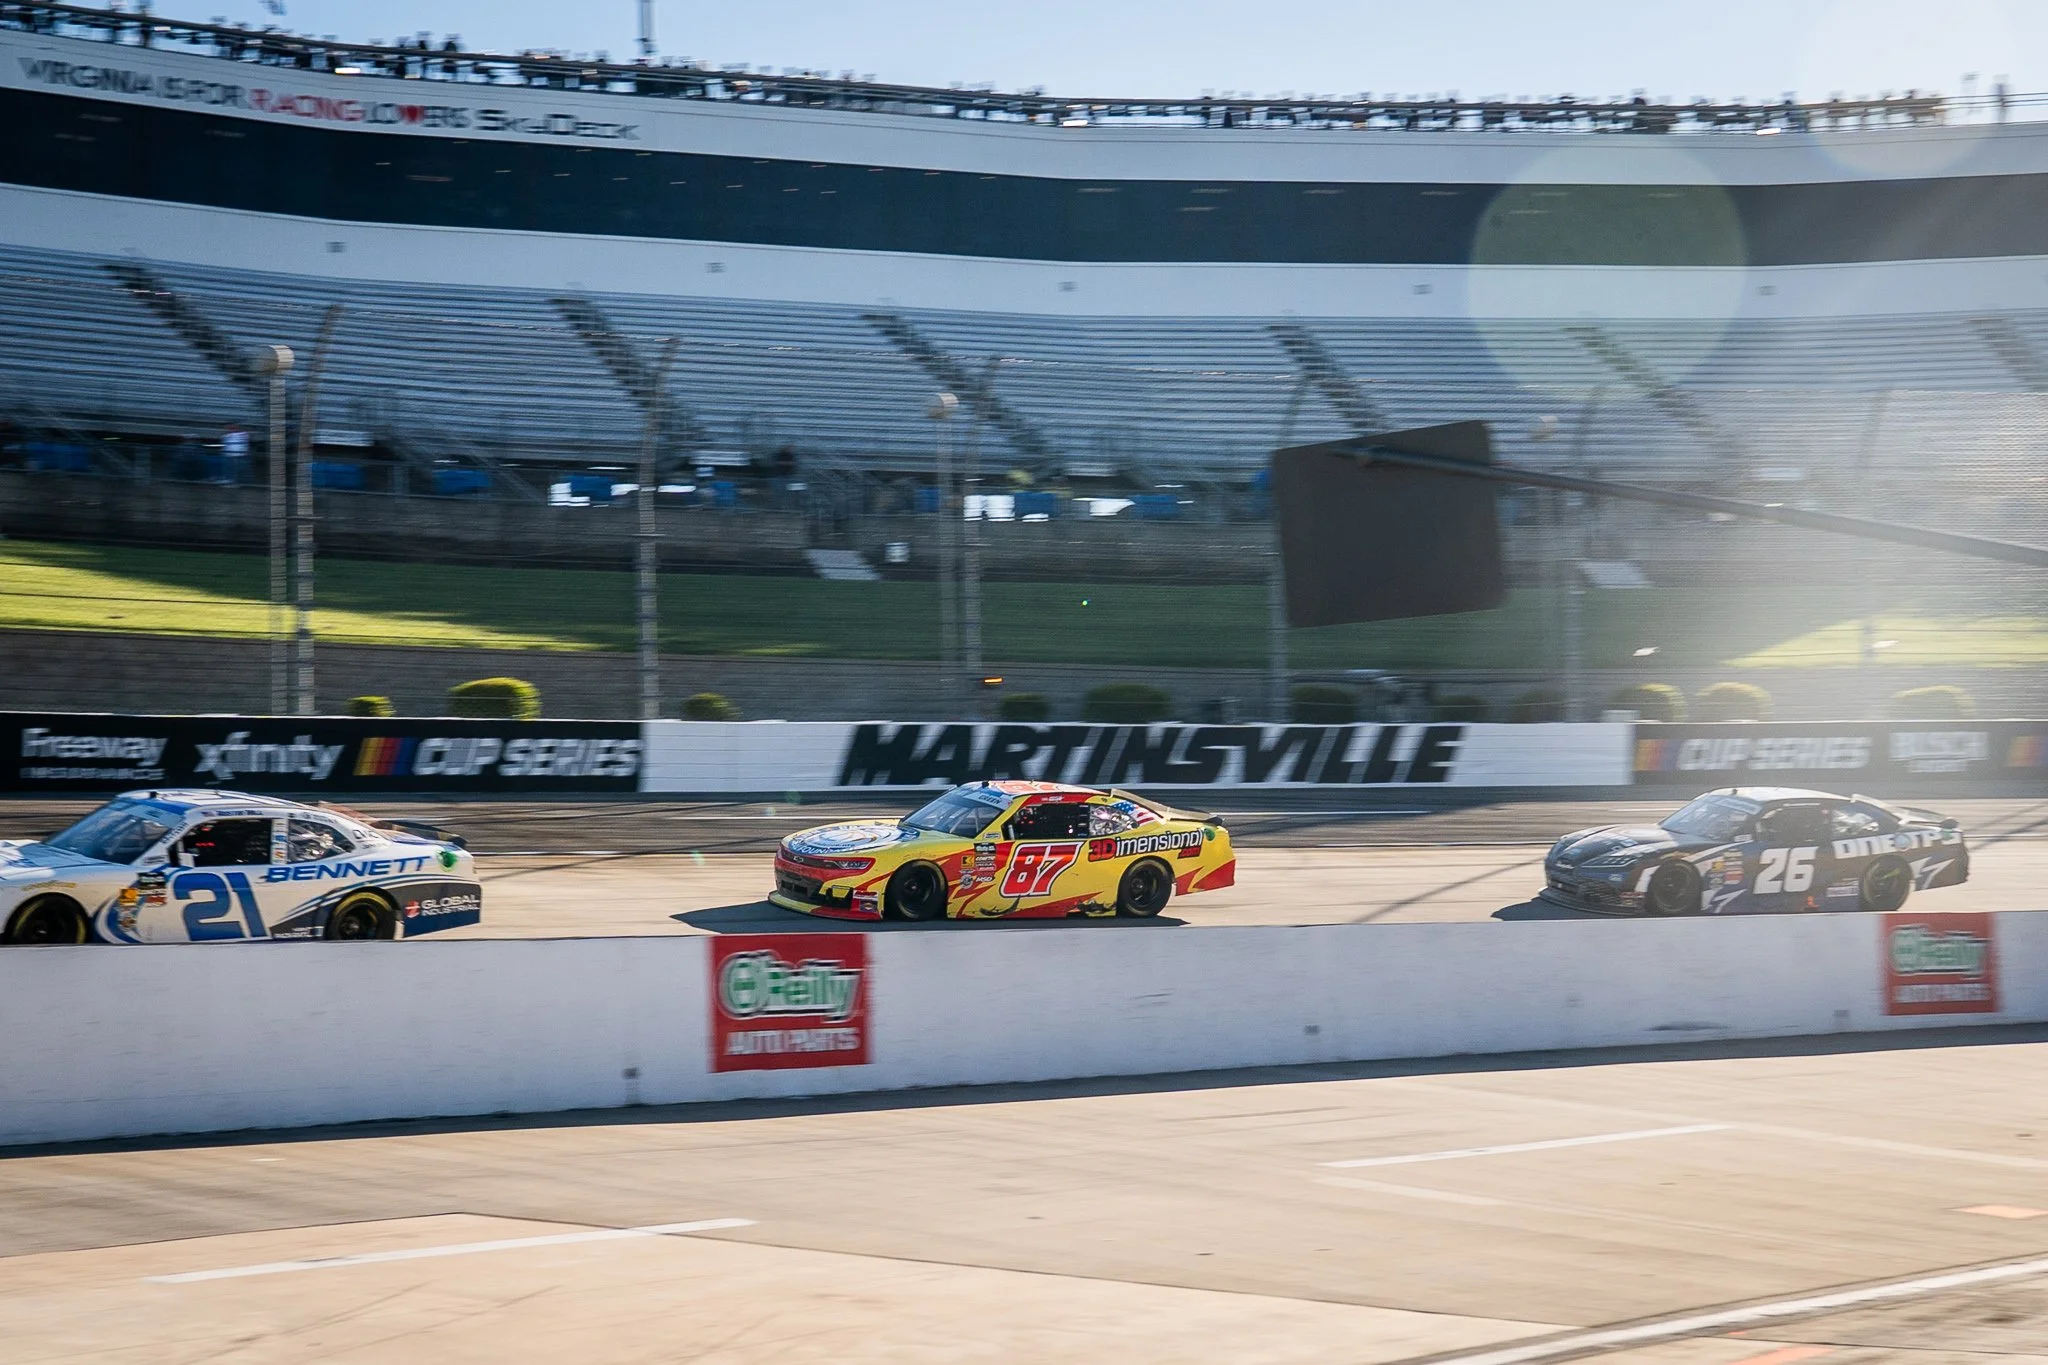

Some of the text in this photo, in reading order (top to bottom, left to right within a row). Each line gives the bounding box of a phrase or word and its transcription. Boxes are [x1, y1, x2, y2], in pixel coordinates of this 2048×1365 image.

[250, 87, 364, 122] RACING
[21, 728, 168, 767] Freeway
[193, 731, 345, 780] xfinity
[412, 737, 643, 776] CUP SERIES
[836, 724, 1468, 786] MARTINSVILLE
[1677, 737, 1751, 770] CUP
[1747, 736, 1872, 769] SERIES
[1088, 828, 1204, 862] 3Dimensional
[266, 856, 432, 882] BENNETT
[1000, 841, 1084, 898] 87
[1752, 846, 1819, 894] 26
[173, 872, 268, 941] 21
[421, 894, 480, 909] GLOBAL
